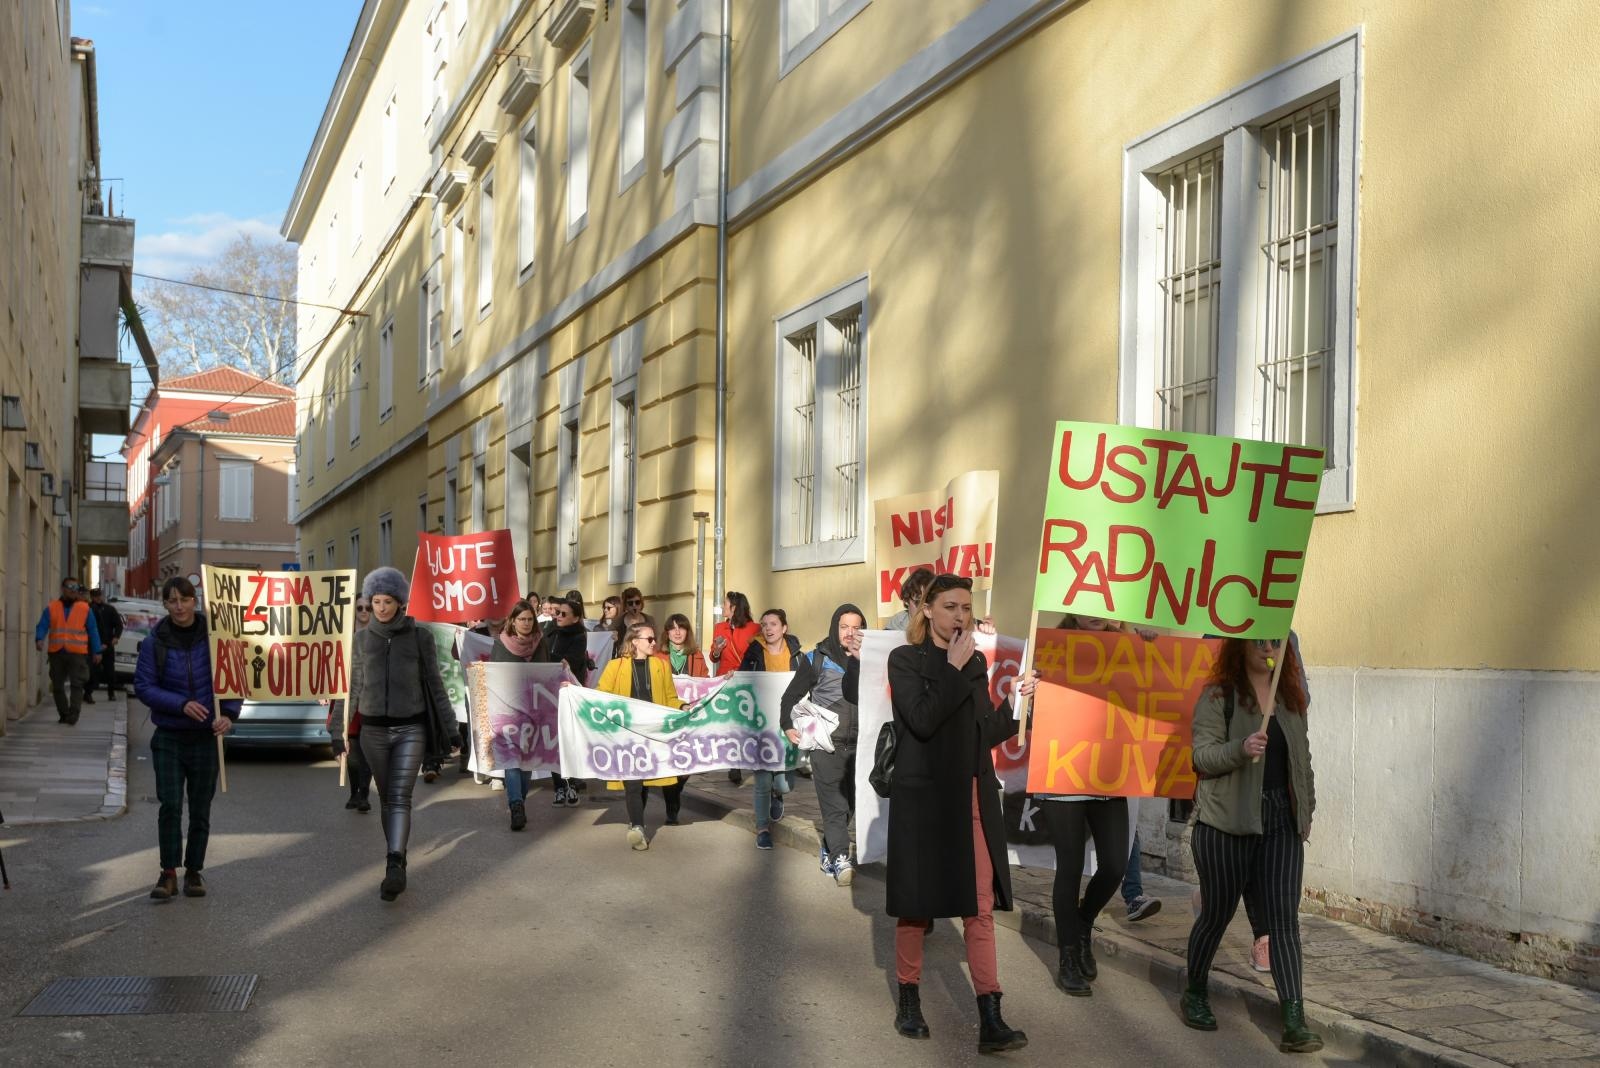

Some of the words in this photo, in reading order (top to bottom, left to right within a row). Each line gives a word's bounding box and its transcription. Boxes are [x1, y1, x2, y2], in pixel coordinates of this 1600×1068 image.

[1058, 430, 1325, 523] USTAJTE
[890, 496, 954, 548] NISI
[213, 572, 241, 602] DAN
[321, 575, 351, 607] JE
[432, 576, 499, 612] SMO!
[1039, 518, 1304, 634] RADNICE
[298, 602, 344, 636] DAN
[267, 640, 348, 697] OTPORA
[590, 706, 625, 727] on
[1105, 690, 1185, 743] NE
